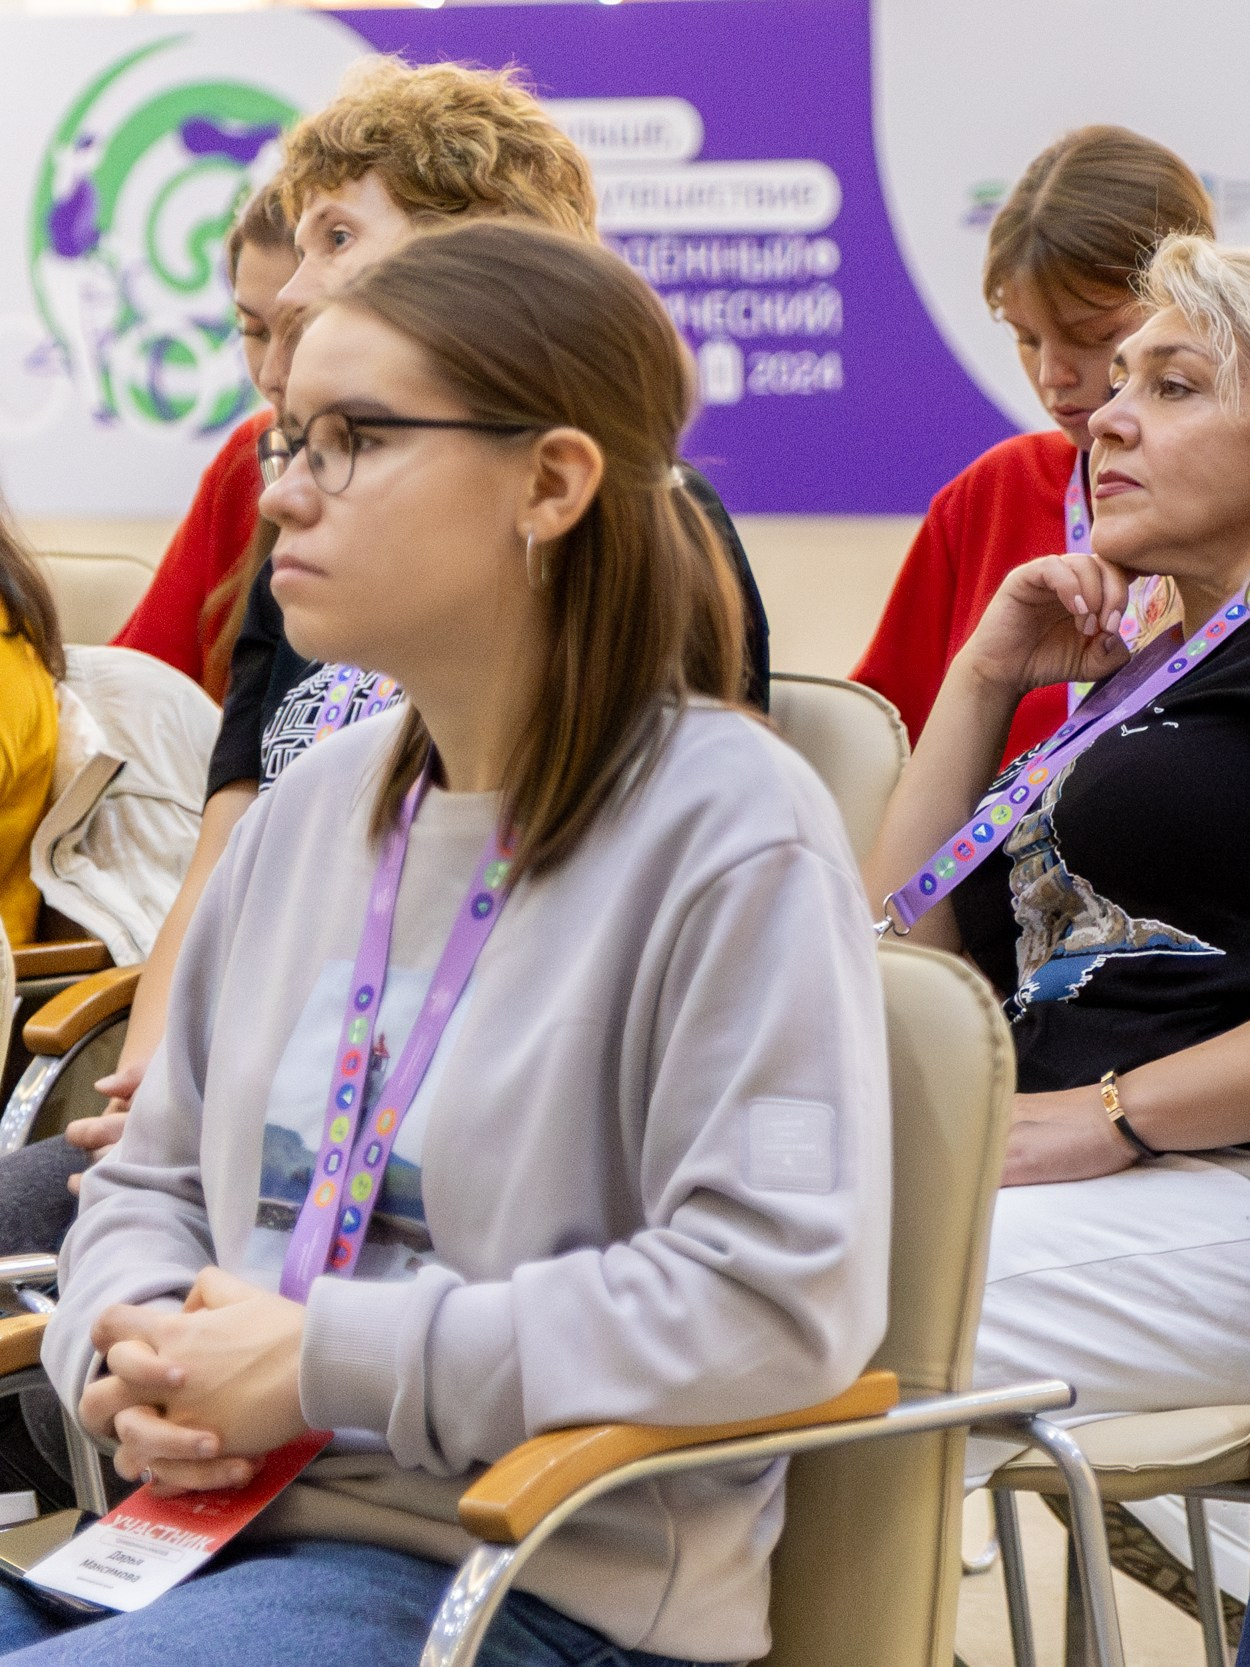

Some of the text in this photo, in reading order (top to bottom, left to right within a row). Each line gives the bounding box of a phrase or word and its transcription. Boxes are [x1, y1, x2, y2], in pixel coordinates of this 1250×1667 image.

[600, 181, 816, 214] утешествие
[747, 350, 843, 395] 2024
[111, 1514, 216, 1551] УЧАСТНИК
